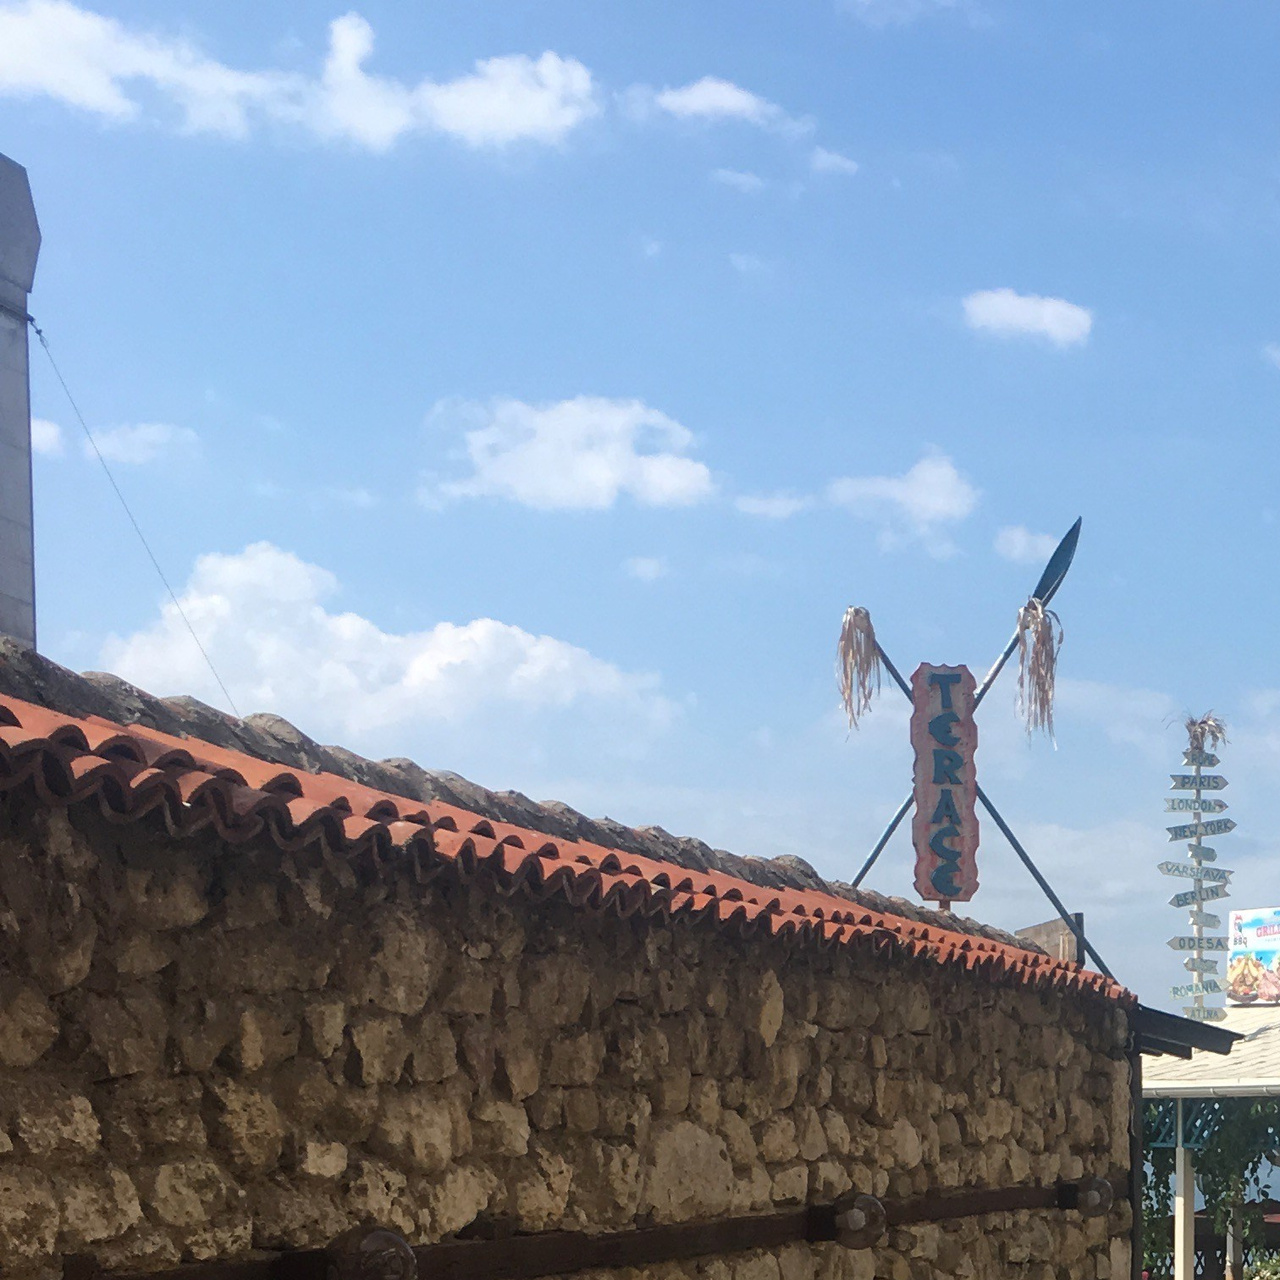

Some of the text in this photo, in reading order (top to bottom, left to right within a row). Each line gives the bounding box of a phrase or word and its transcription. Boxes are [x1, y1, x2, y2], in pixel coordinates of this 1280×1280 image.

[1181, 775, 1219, 788] PARIS
[1173, 820, 1230, 839] NEW YORK
[1166, 863, 1226, 880] VARSHAVA
[1176, 888, 1220, 907] BERLIN
[1178, 938, 1225, 950] ODESA
[1234, 936, 1248, 948] BBQ
[1171, 981, 1221, 998] ROMANIA
[1190, 1008, 1219, 1020] ATINA
